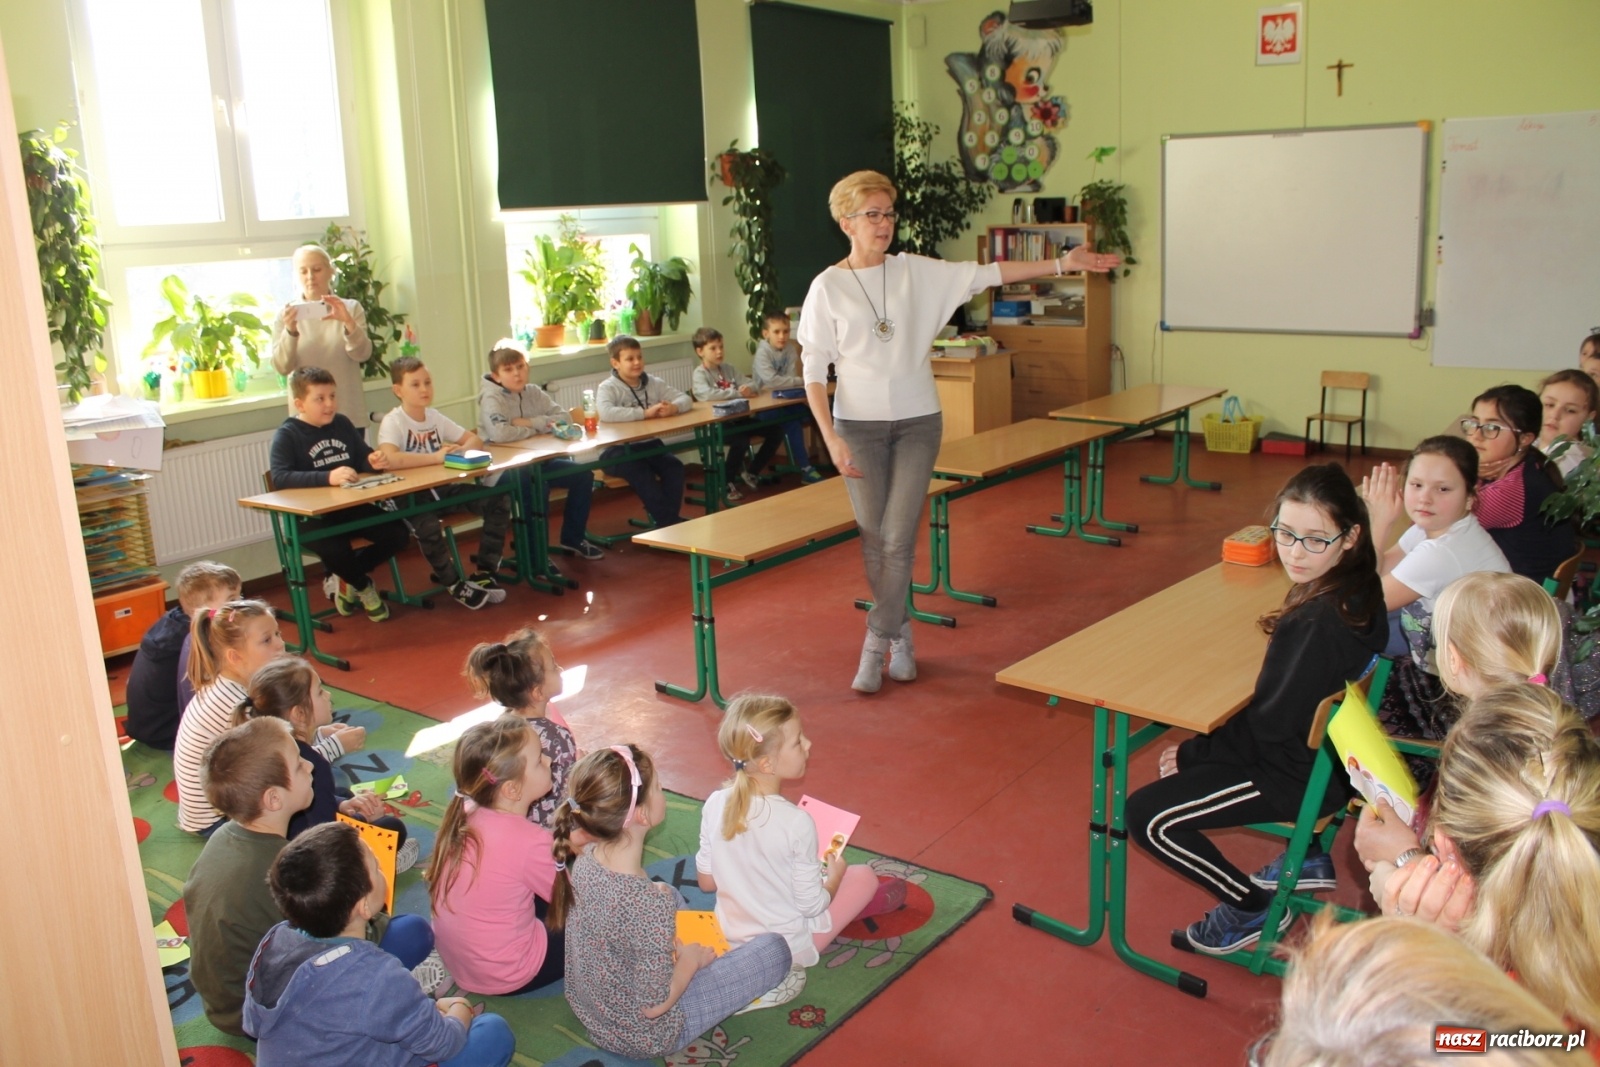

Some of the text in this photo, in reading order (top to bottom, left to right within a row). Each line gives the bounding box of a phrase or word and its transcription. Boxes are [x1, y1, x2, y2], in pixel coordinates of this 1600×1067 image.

[990, 68, 996, 77] 8
[969, 82, 975, 91] 5
[999, 112, 1005, 121] 6
[1031, 122, 1041, 131] 10
[968, 134, 974, 143] 4
[990, 134, 996, 143] 3
[1014, 131, 1020, 140] 9
[981, 157, 987, 166] 7
[313, 459, 325, 468] LOS
[325, 452, 350, 465] ANGELES
